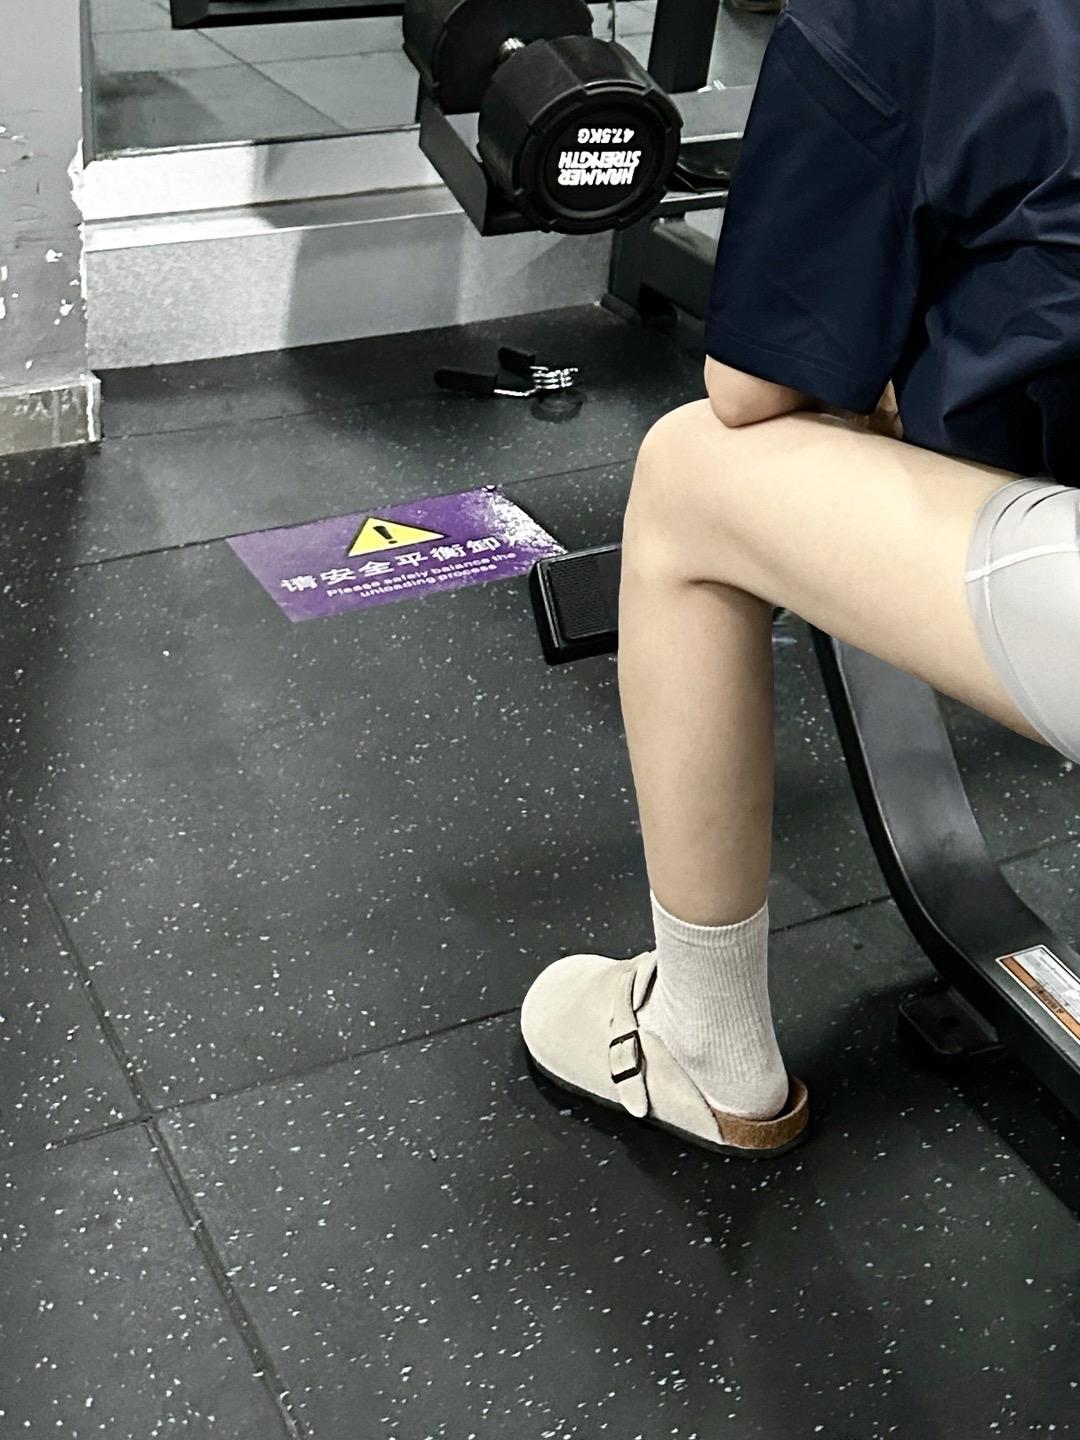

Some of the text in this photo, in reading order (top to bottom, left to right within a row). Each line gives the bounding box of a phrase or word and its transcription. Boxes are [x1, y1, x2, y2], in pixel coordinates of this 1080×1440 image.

[577, 127, 635, 144] 47.5KG
[558, 151, 642, 169] STRENGTH
[557, 167, 636, 185] HAMMER
[281, 536, 520, 593] 请安全平衡卸
[327, 552, 517, 598] Please safely balance the
[360, 563, 498, 598] unloading process
